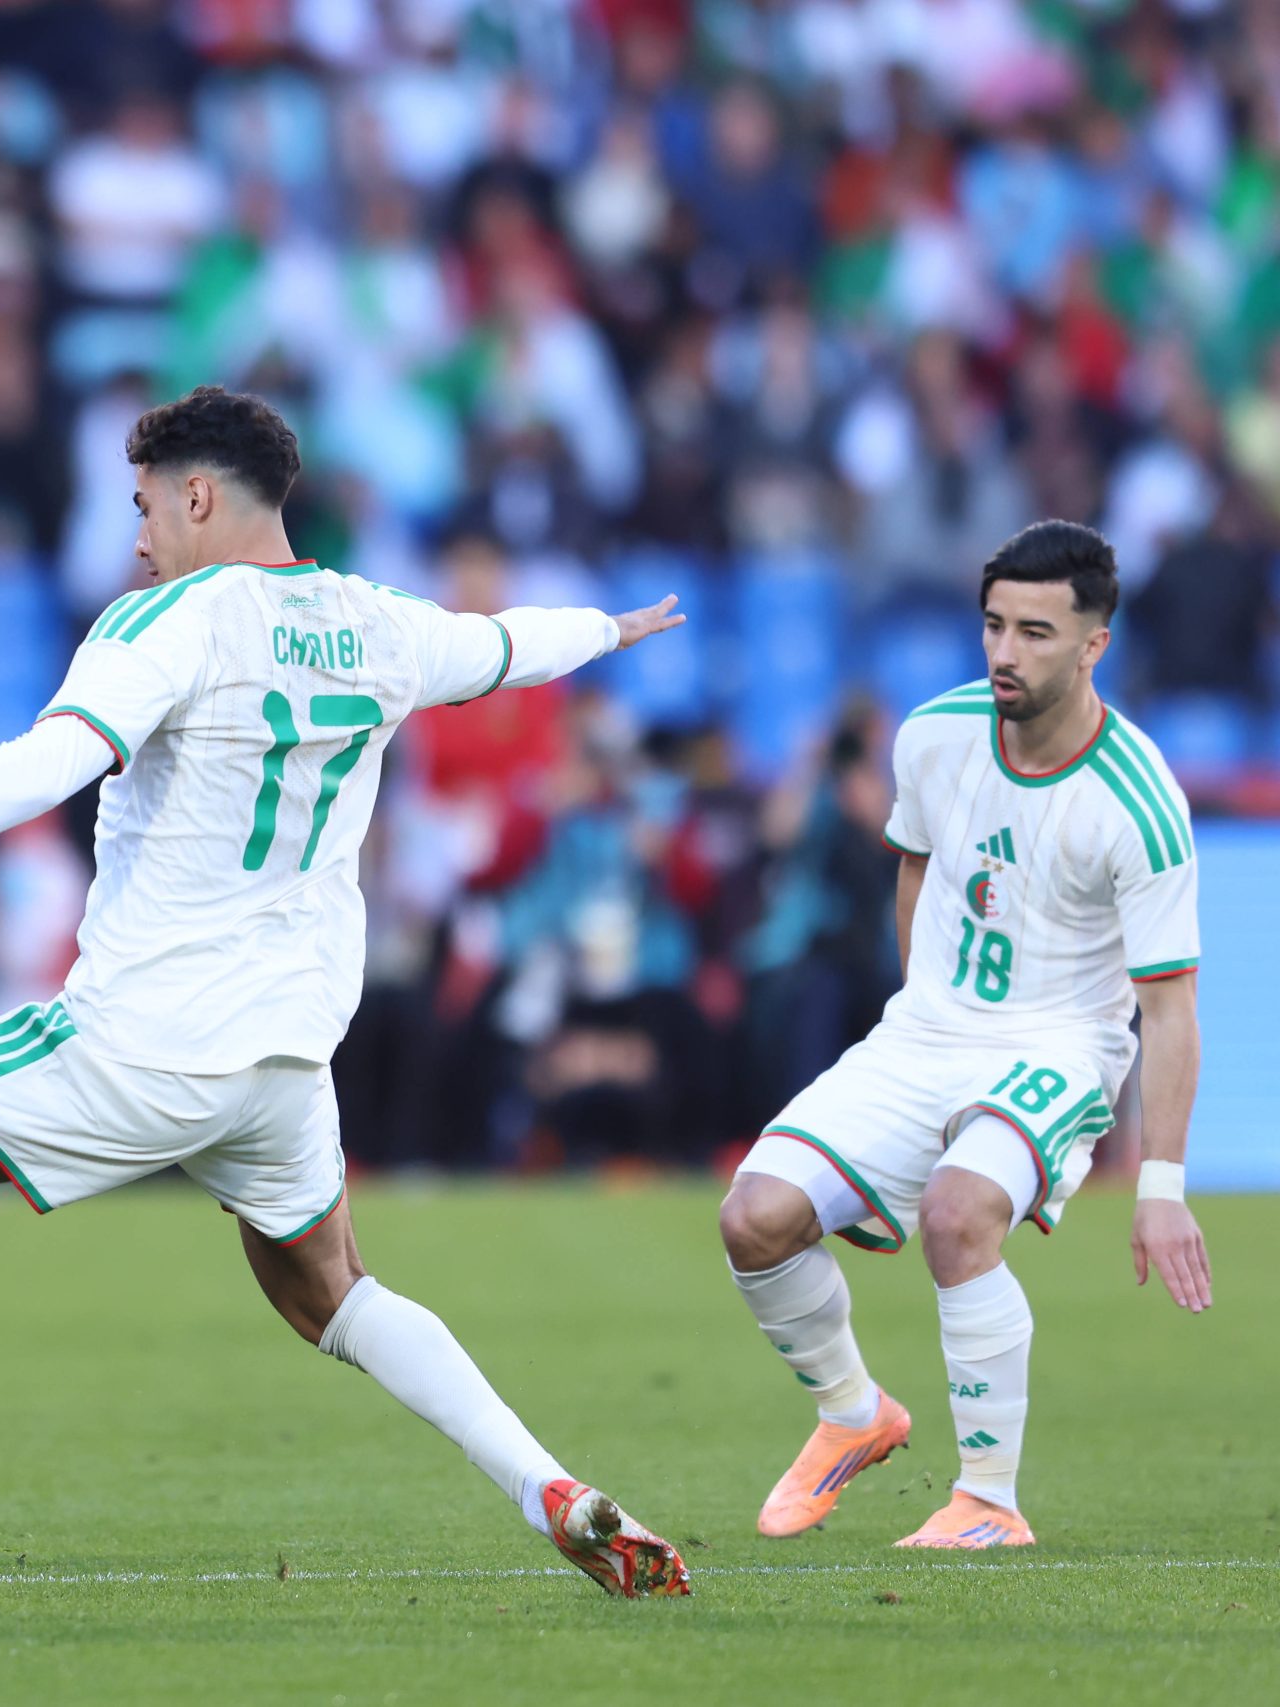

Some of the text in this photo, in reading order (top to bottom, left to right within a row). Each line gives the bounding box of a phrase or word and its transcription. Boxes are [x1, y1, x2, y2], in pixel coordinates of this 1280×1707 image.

[242, 690, 384, 872] 17
[951, 916, 1013, 1002] 18
[988, 1061, 1067, 1114] 18
